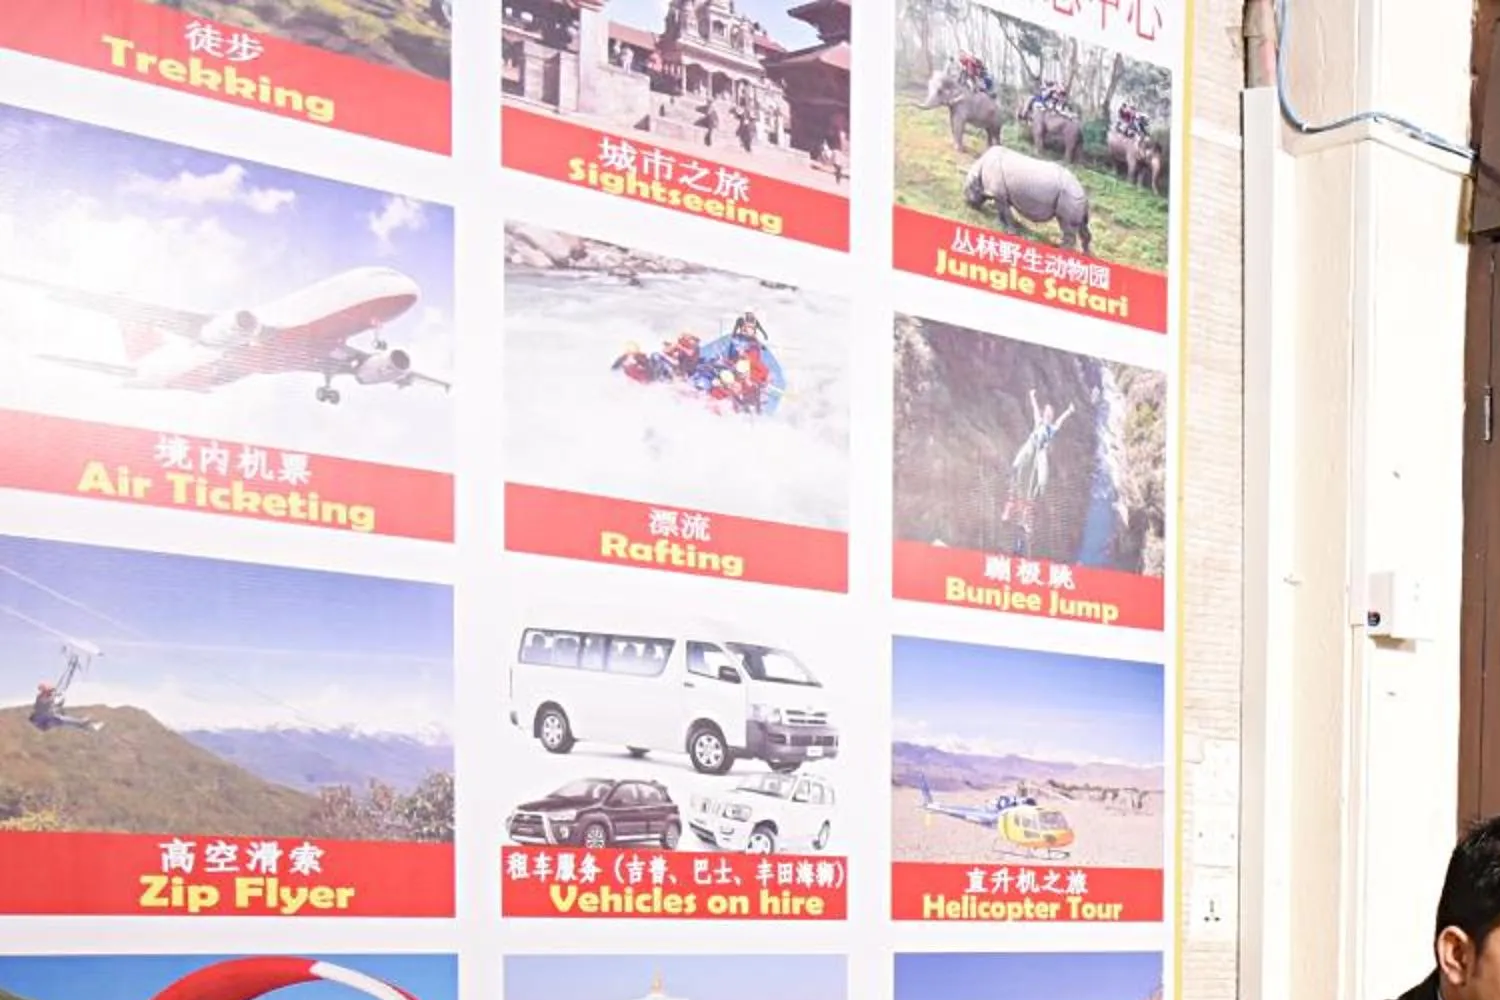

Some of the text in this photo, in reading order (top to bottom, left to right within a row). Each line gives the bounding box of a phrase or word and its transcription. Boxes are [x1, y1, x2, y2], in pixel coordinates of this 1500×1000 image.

[184, 20, 264, 62] 徒步
[102, 34, 335, 123] Trekking
[598, 136, 750, 202] 城市之旅
[568, 157, 783, 234] Sightseeing
[951, 227, 1111, 289] 丛林野生动物园
[936, 249, 1128, 317] Jungle Safari
[153, 432, 311, 484] 境内机票
[77, 460, 375, 532] Air Ticketing
[649, 507, 711, 541] 漂流
[601, 531, 743, 576] Rafting
[945, 576, 1119, 625] Bunjee Jump
[159, 838, 325, 875] 高空滑索
[139, 875, 355, 914] Zip Flyer
[550, 885, 825, 915] Vehicles on hire
[964, 867, 1088, 894] 直升机之旅
[923, 893, 1123, 922] Helicopter Tour
